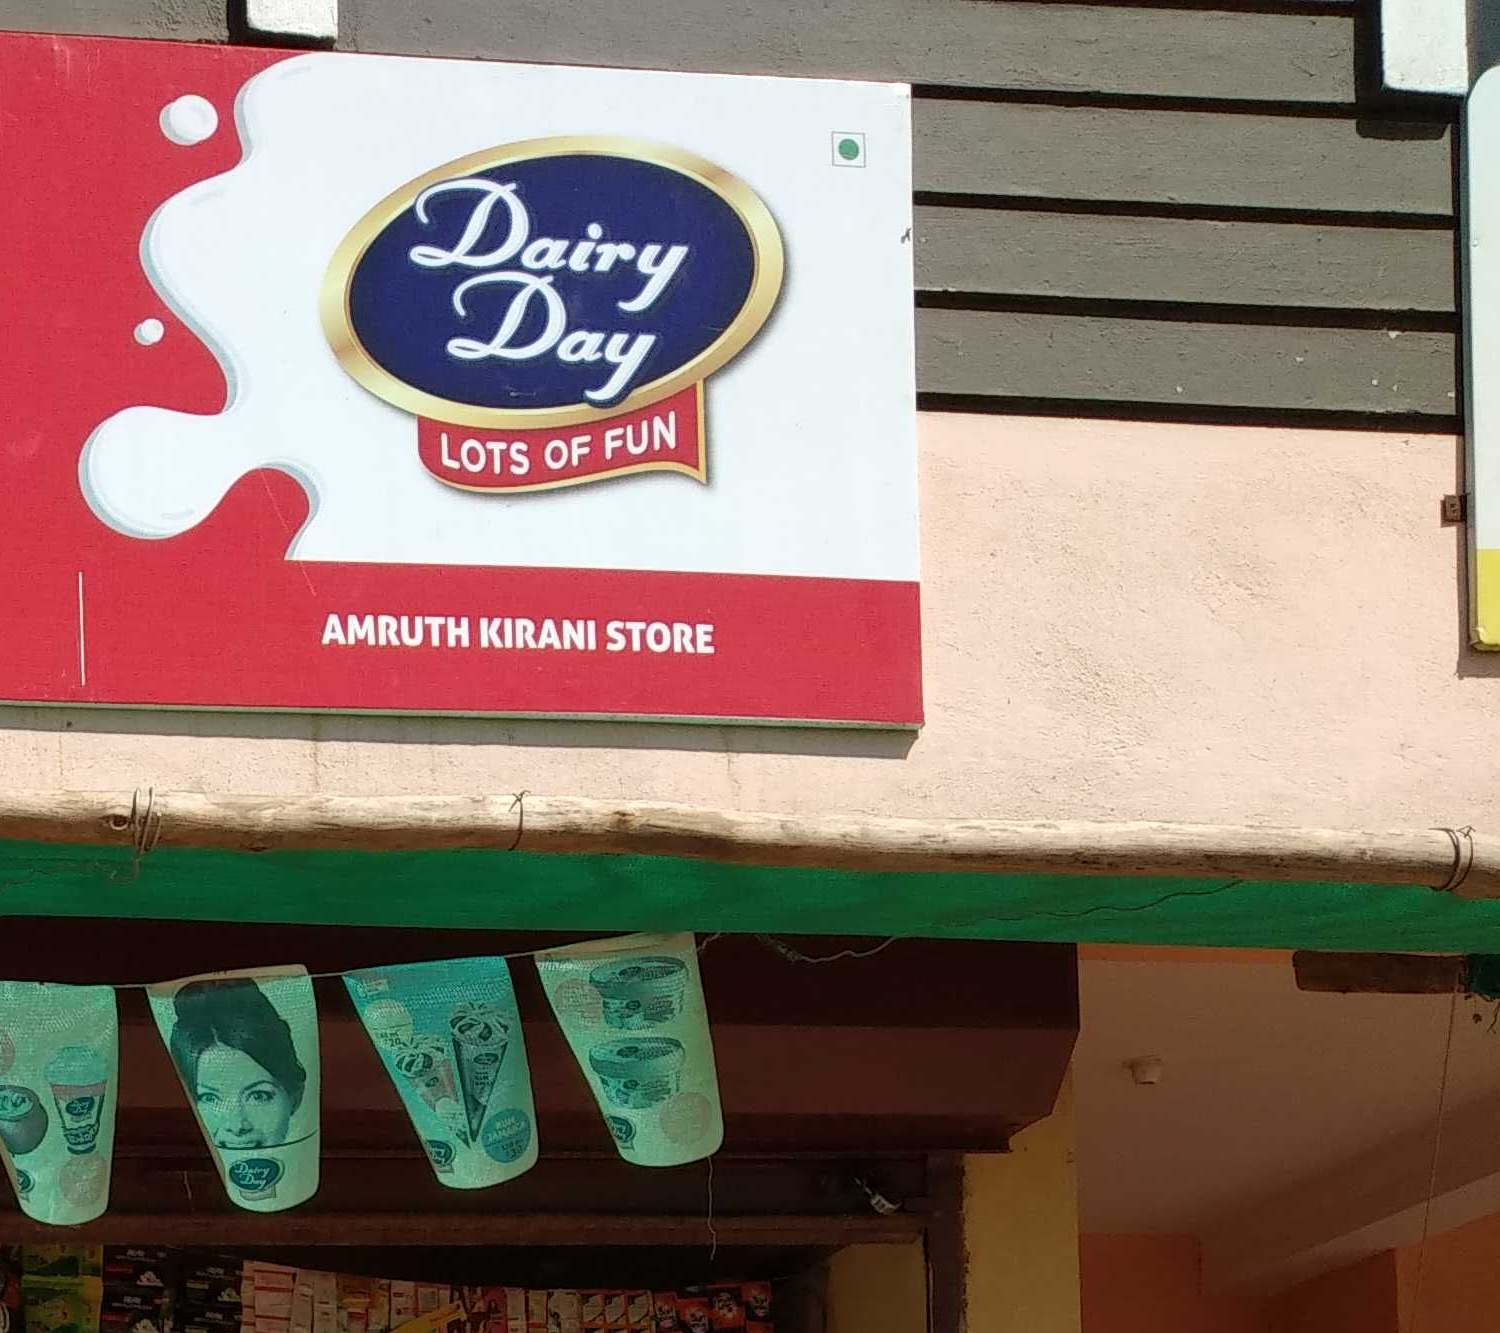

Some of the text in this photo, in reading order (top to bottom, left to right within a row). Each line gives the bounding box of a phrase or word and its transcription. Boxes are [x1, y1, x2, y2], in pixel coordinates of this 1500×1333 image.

[410, 178, 690, 312] Dairy
[446, 272, 658, 402] Day
[439, 410, 678, 477] LOTS OF FUN
[321, 612, 716, 656] AMRUTH KIRANI STORE
[233, 1160, 271, 1178] Dairy
[239, 1173, 268, 1191] Day
